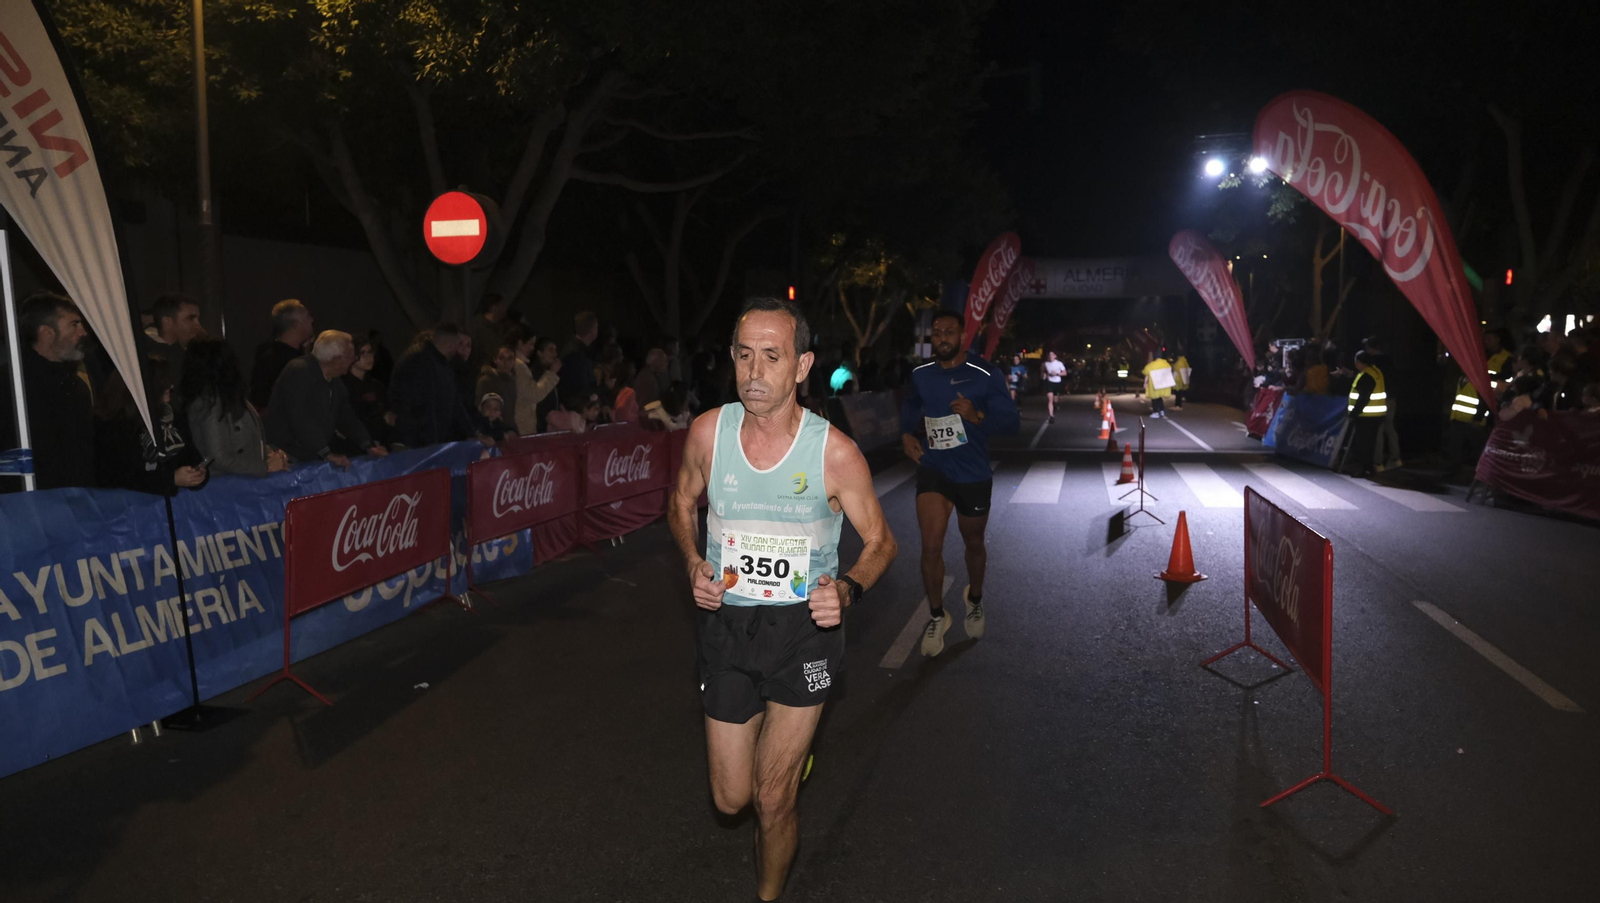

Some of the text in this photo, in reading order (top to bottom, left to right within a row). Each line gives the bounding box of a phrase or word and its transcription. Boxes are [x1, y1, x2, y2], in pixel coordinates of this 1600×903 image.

[970, 240, 1017, 321] Coca-Cola
[931, 427, 954, 439] 378
[604, 444, 652, 487] Coca-Cola
[493, 461, 556, 518] Coca-Cola
[732, 501, 782, 513] Ayuntamiento
[783, 504, 793, 513] de
[332, 491, 423, 572] Coca-Cola
[740, 555, 790, 578] 350
[747, 578, 781, 587] MALDONADO
[84, 575, 265, 666] ALMERÍA
[803, 662, 812, 670] IX
[804, 670, 830, 683] VERA
[807, 677, 832, 692] CASE
